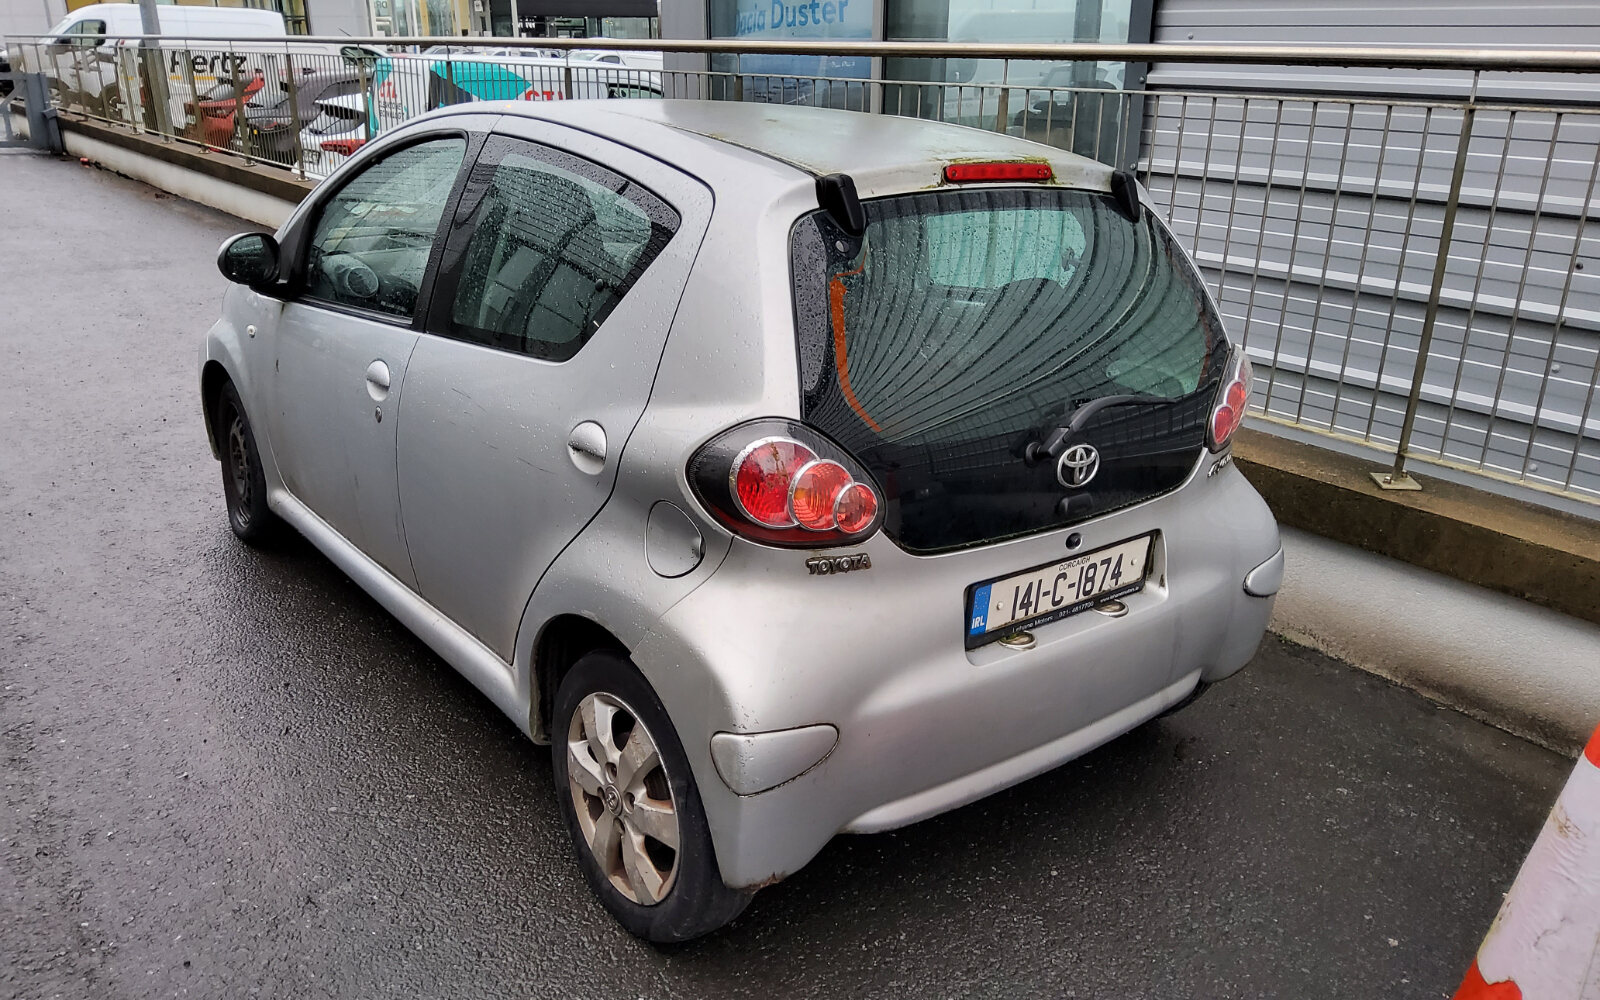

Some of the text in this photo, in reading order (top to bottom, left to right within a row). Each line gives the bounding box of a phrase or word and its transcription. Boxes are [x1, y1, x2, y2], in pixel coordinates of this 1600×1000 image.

[771, 0, 849, 29] Duster
[807, 553, 871, 575] TOYOTA
[1058, 556, 1091, 572] CORCAIGH
[1010, 553, 1124, 621] 141-C-1874
[971, 615, 985, 630] IRL
[1034, 615, 1054, 627] Motors
